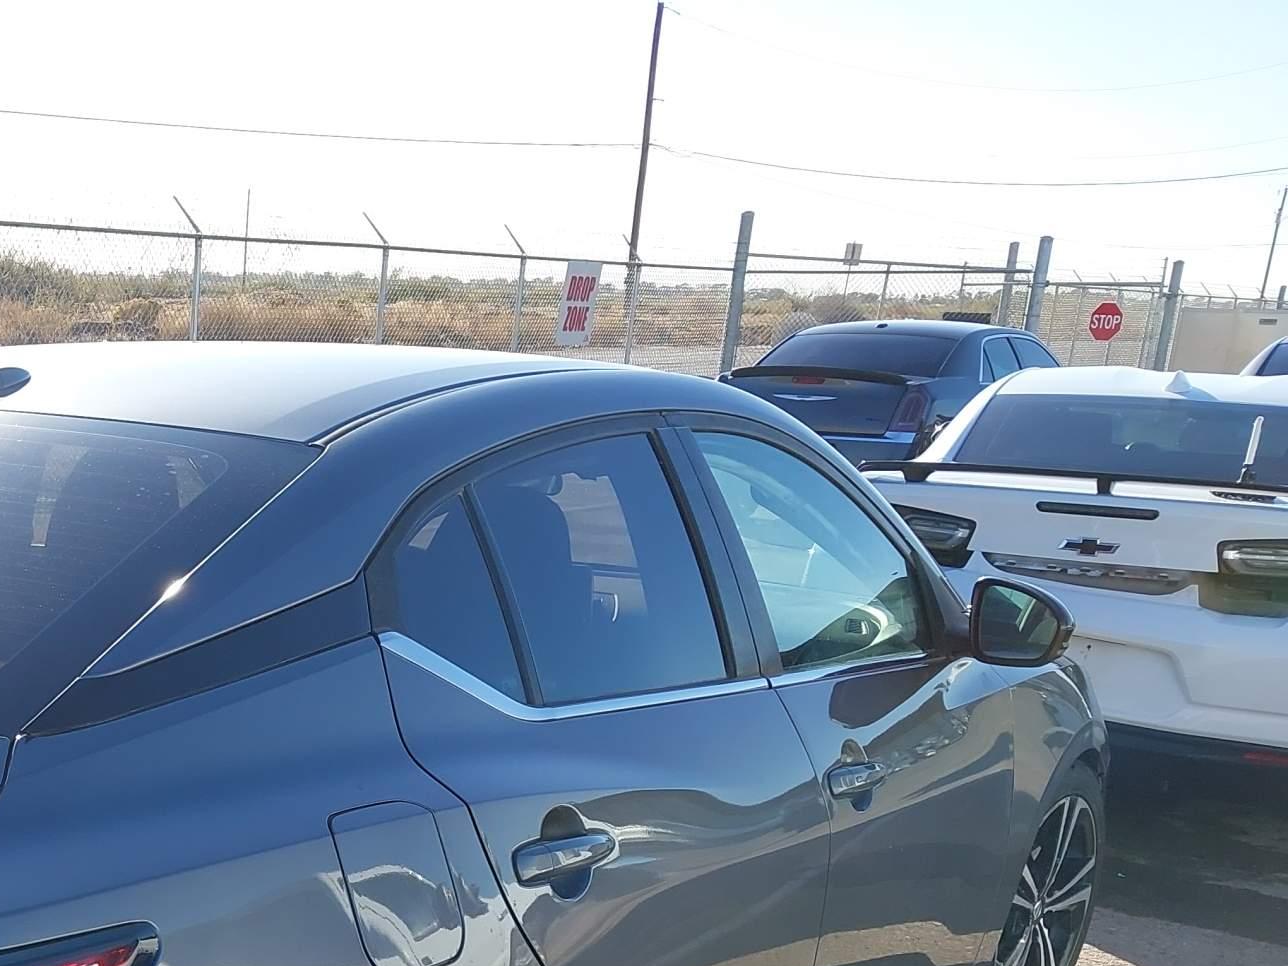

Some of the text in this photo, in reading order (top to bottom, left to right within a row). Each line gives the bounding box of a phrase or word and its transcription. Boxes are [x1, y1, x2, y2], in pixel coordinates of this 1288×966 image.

[566, 275, 596, 302] DROP
[562, 305, 590, 332] ZONE
[1091, 314, 1121, 329] STOP
